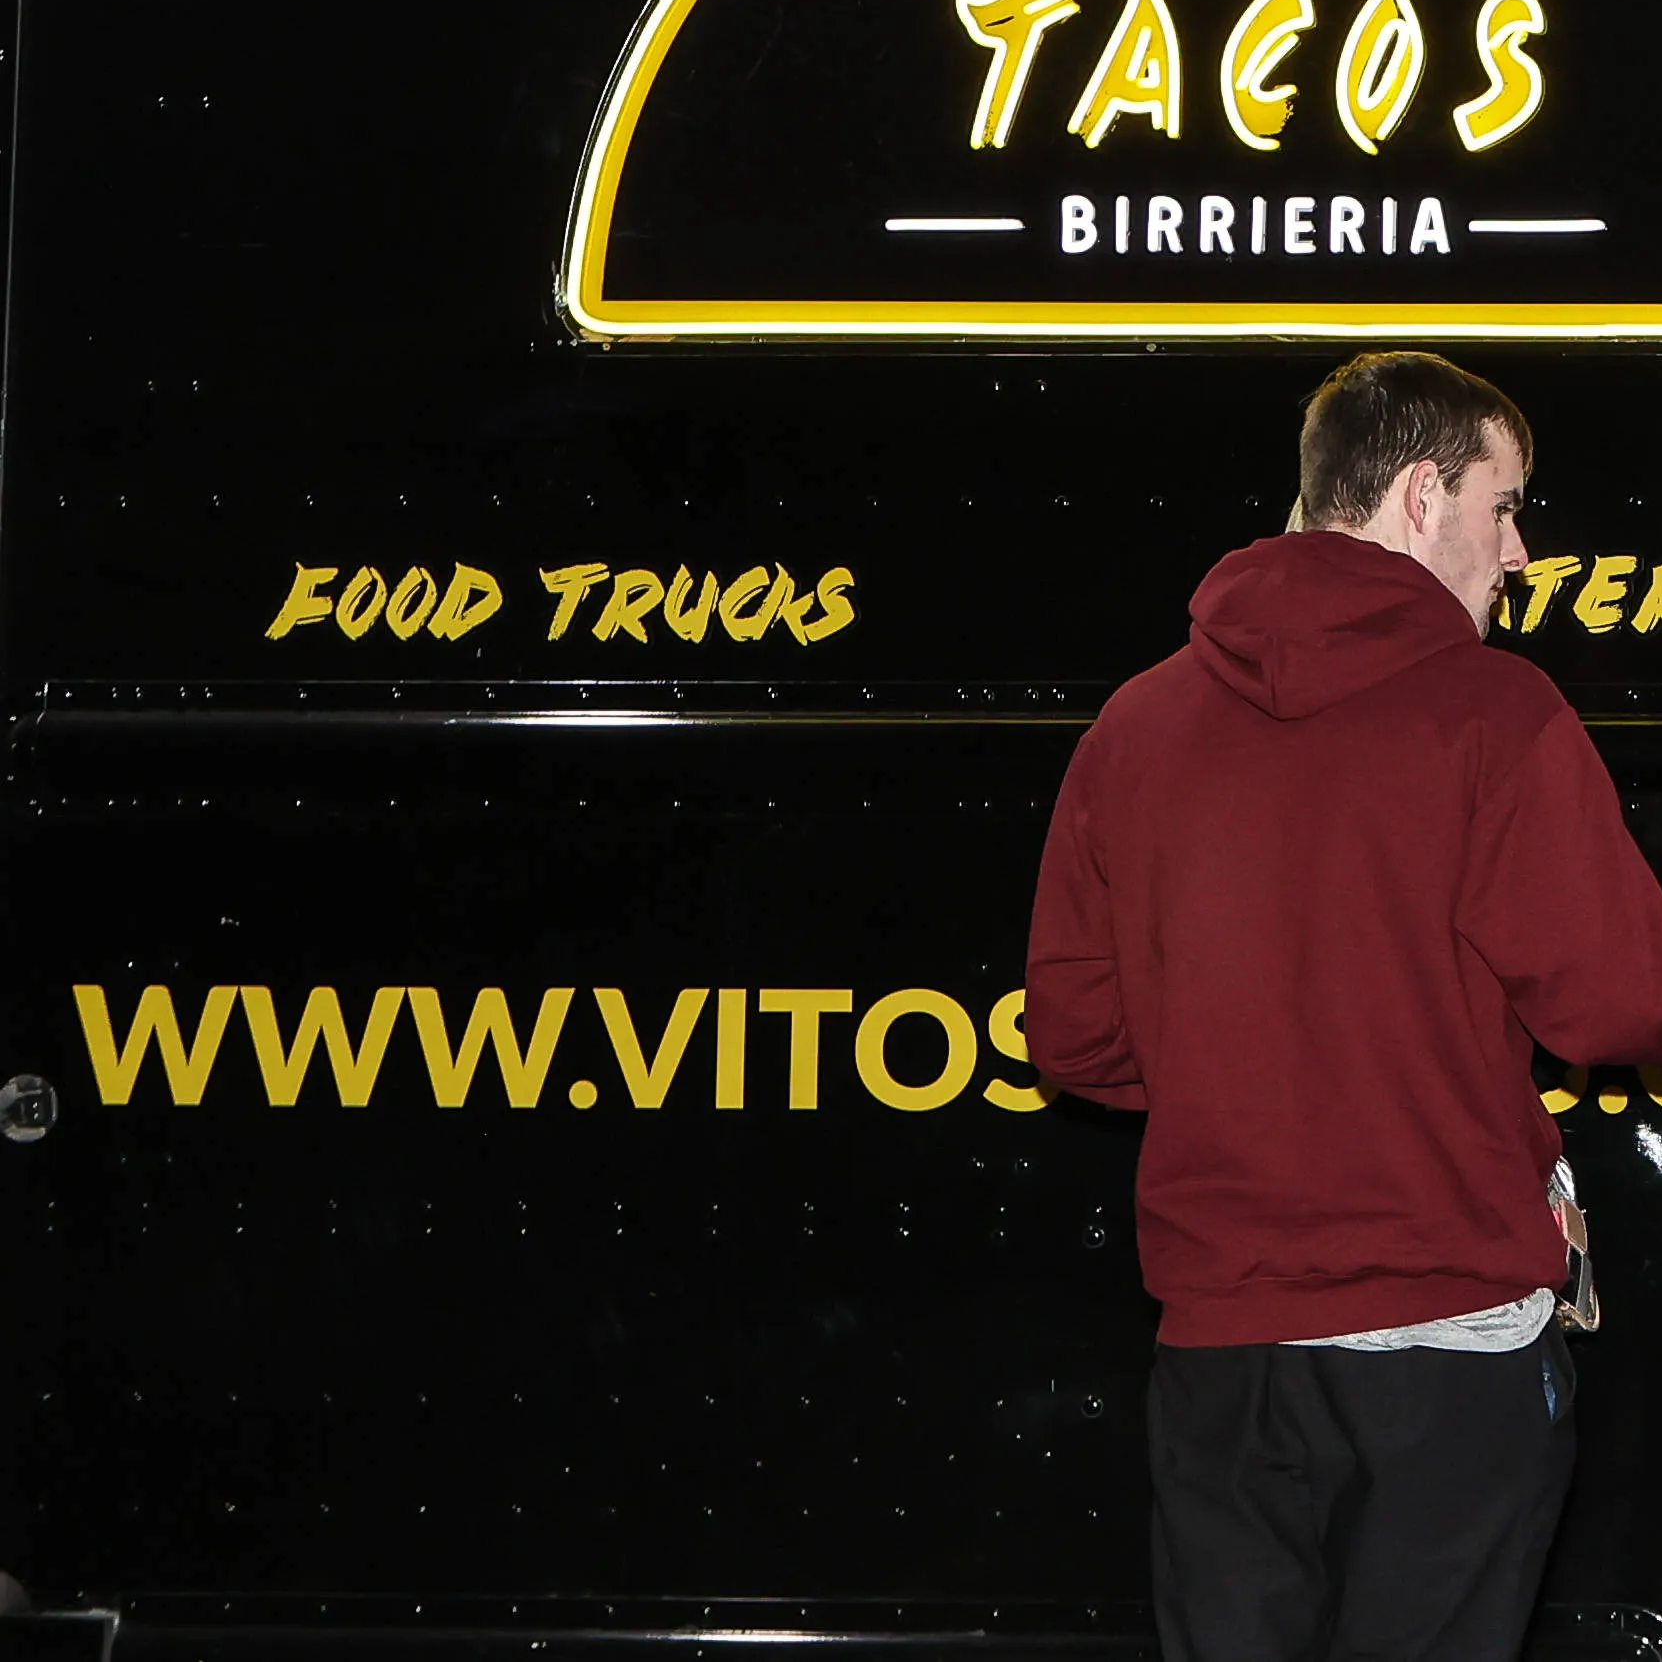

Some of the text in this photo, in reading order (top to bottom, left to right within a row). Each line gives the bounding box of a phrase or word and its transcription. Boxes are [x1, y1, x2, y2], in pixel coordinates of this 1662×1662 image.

[1060, 195, 1452, 255] BIRRIERIA
[264, 562, 856, 646] FOOD TRUCKS
